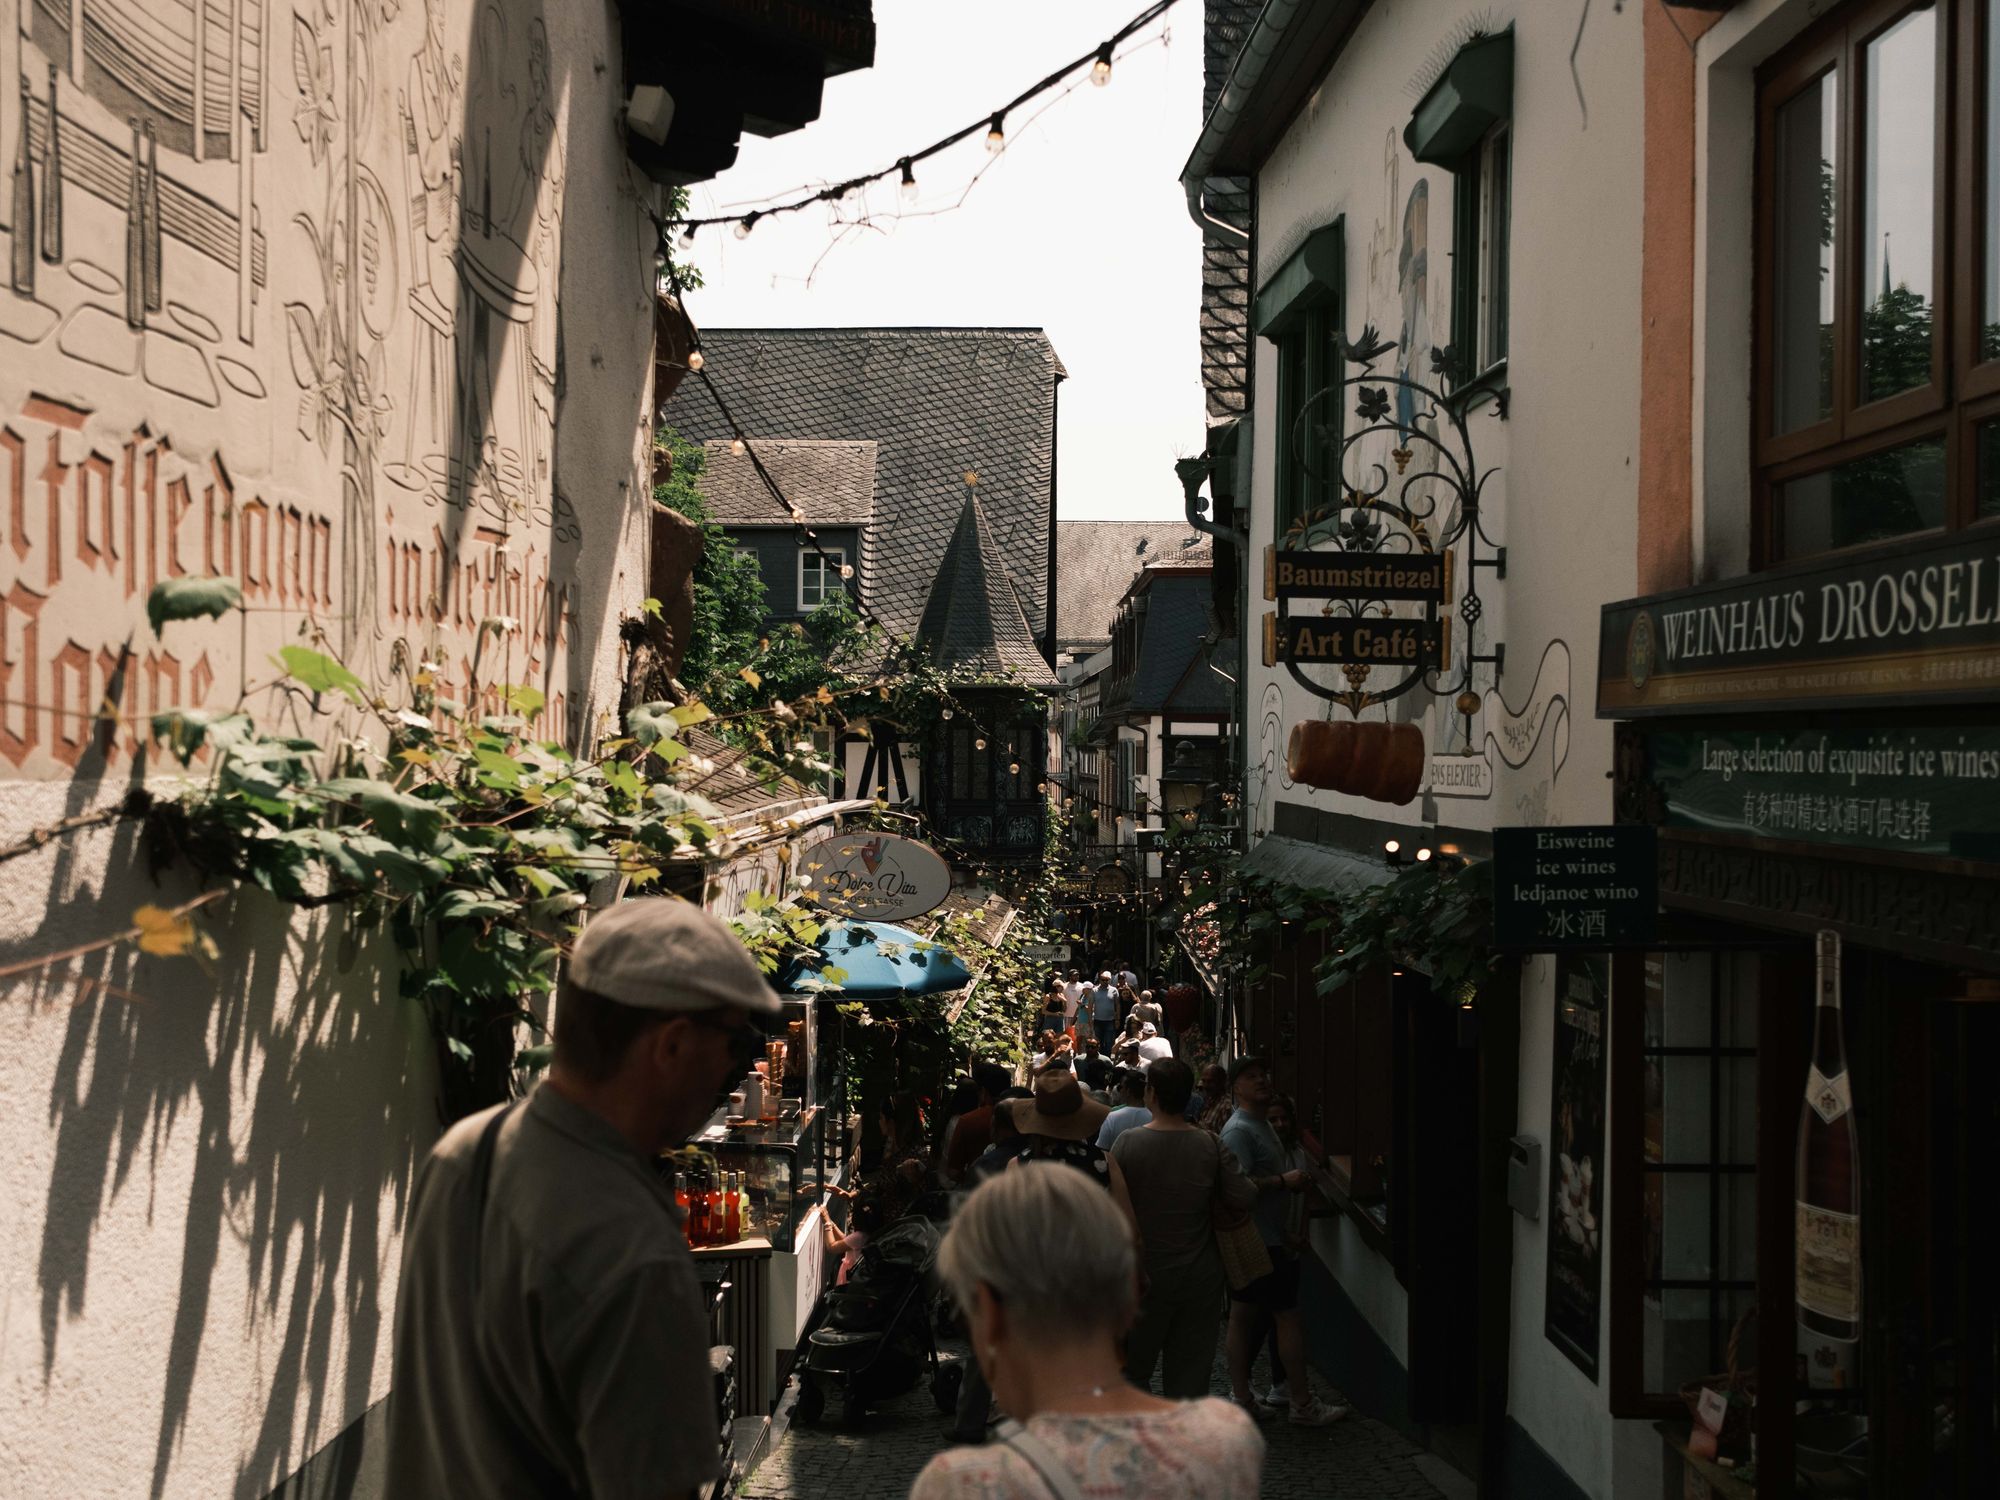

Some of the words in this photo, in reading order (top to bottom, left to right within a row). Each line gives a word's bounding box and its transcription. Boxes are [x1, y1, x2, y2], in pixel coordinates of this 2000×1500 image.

[1277, 561, 1441, 590] Baumstriezel
[1662, 589, 1806, 662] WEINHAUS
[1818, 553, 2000, 645] DROSSEL
[1293, 626, 1344, 657] Art
[1352, 626, 1418, 659] Café
[1702, 739, 1739, 782] Large
[1742, 737, 1804, 773] selection
[1807, 735, 1828, 773] of
[1828, 736, 1904, 787] exquisite
[1908, 736, 1936, 777] ice
[1941, 736, 2000, 779] wines
[1535, 832, 1616, 850] Eisweine
[1535, 857, 1561, 876] ice
[1565, 857, 1617, 875] wines
[827, 870, 875, 894] Dolce
[877, 870, 918, 897] Vita
[1513, 883, 1590, 907] ledjanoe
[1593, 882, 1640, 900] wino
[1546, 908, 1607, 939] 冰酒
